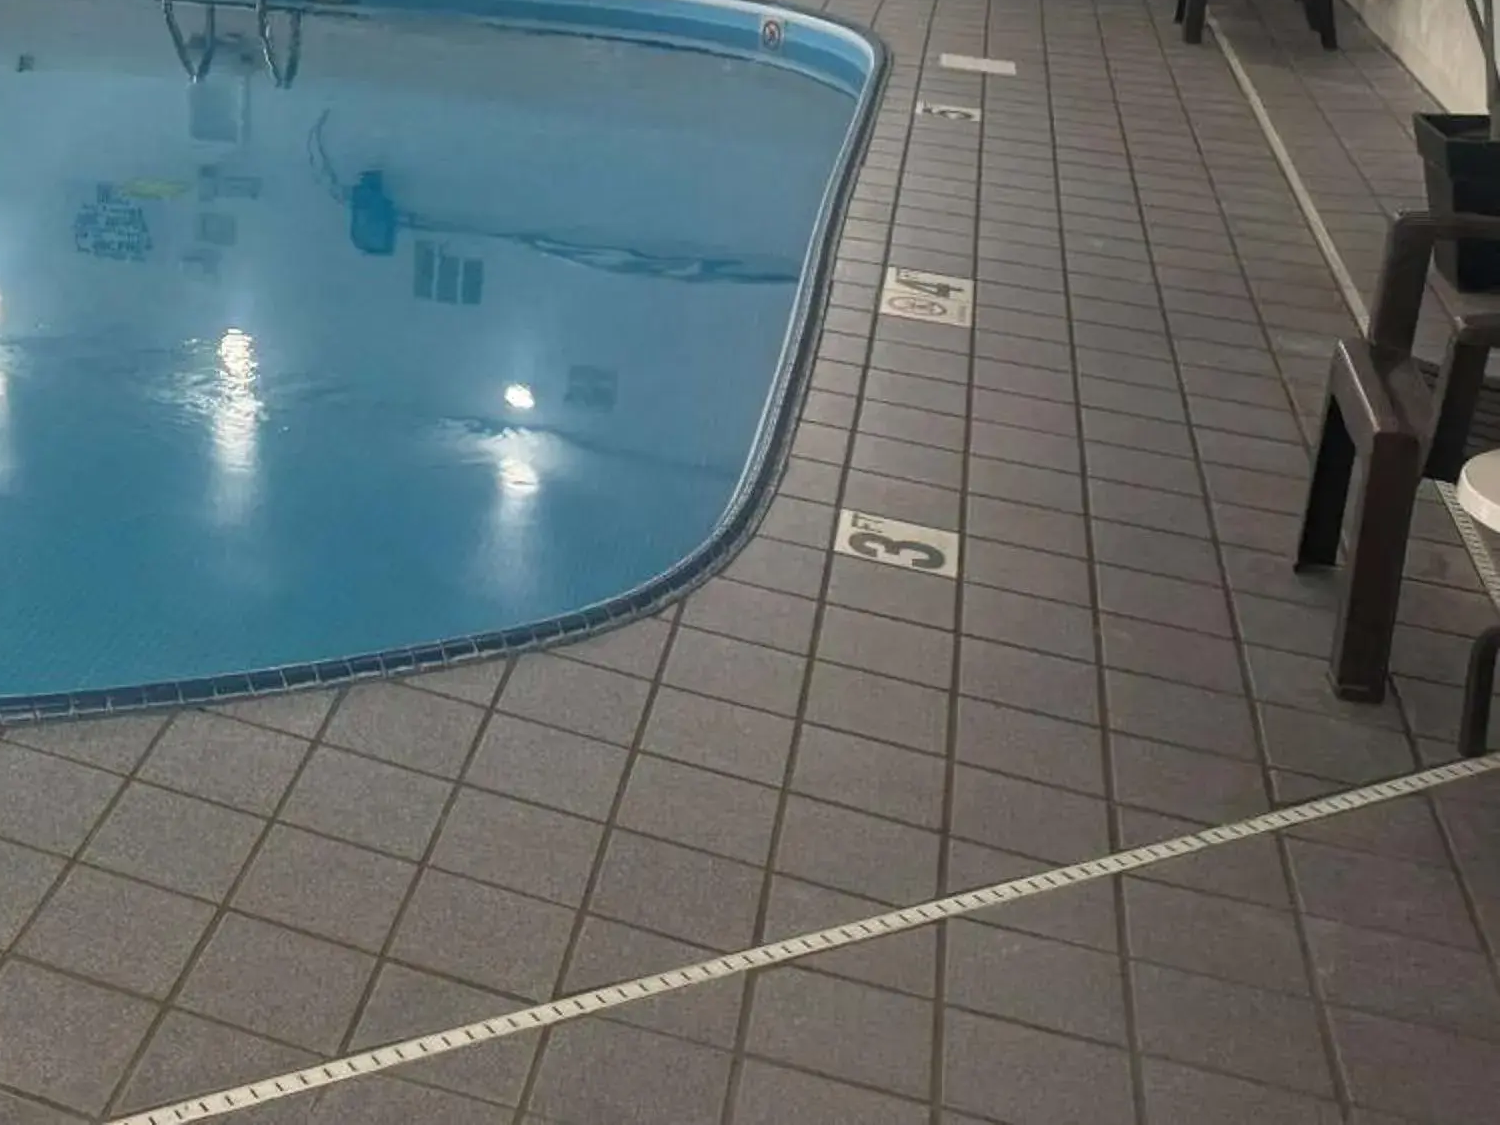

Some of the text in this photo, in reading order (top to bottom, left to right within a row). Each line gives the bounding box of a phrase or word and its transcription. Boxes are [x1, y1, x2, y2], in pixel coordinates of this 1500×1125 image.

[896, 279, 964, 298] 4
[848, 513, 946, 569] 3 FT
